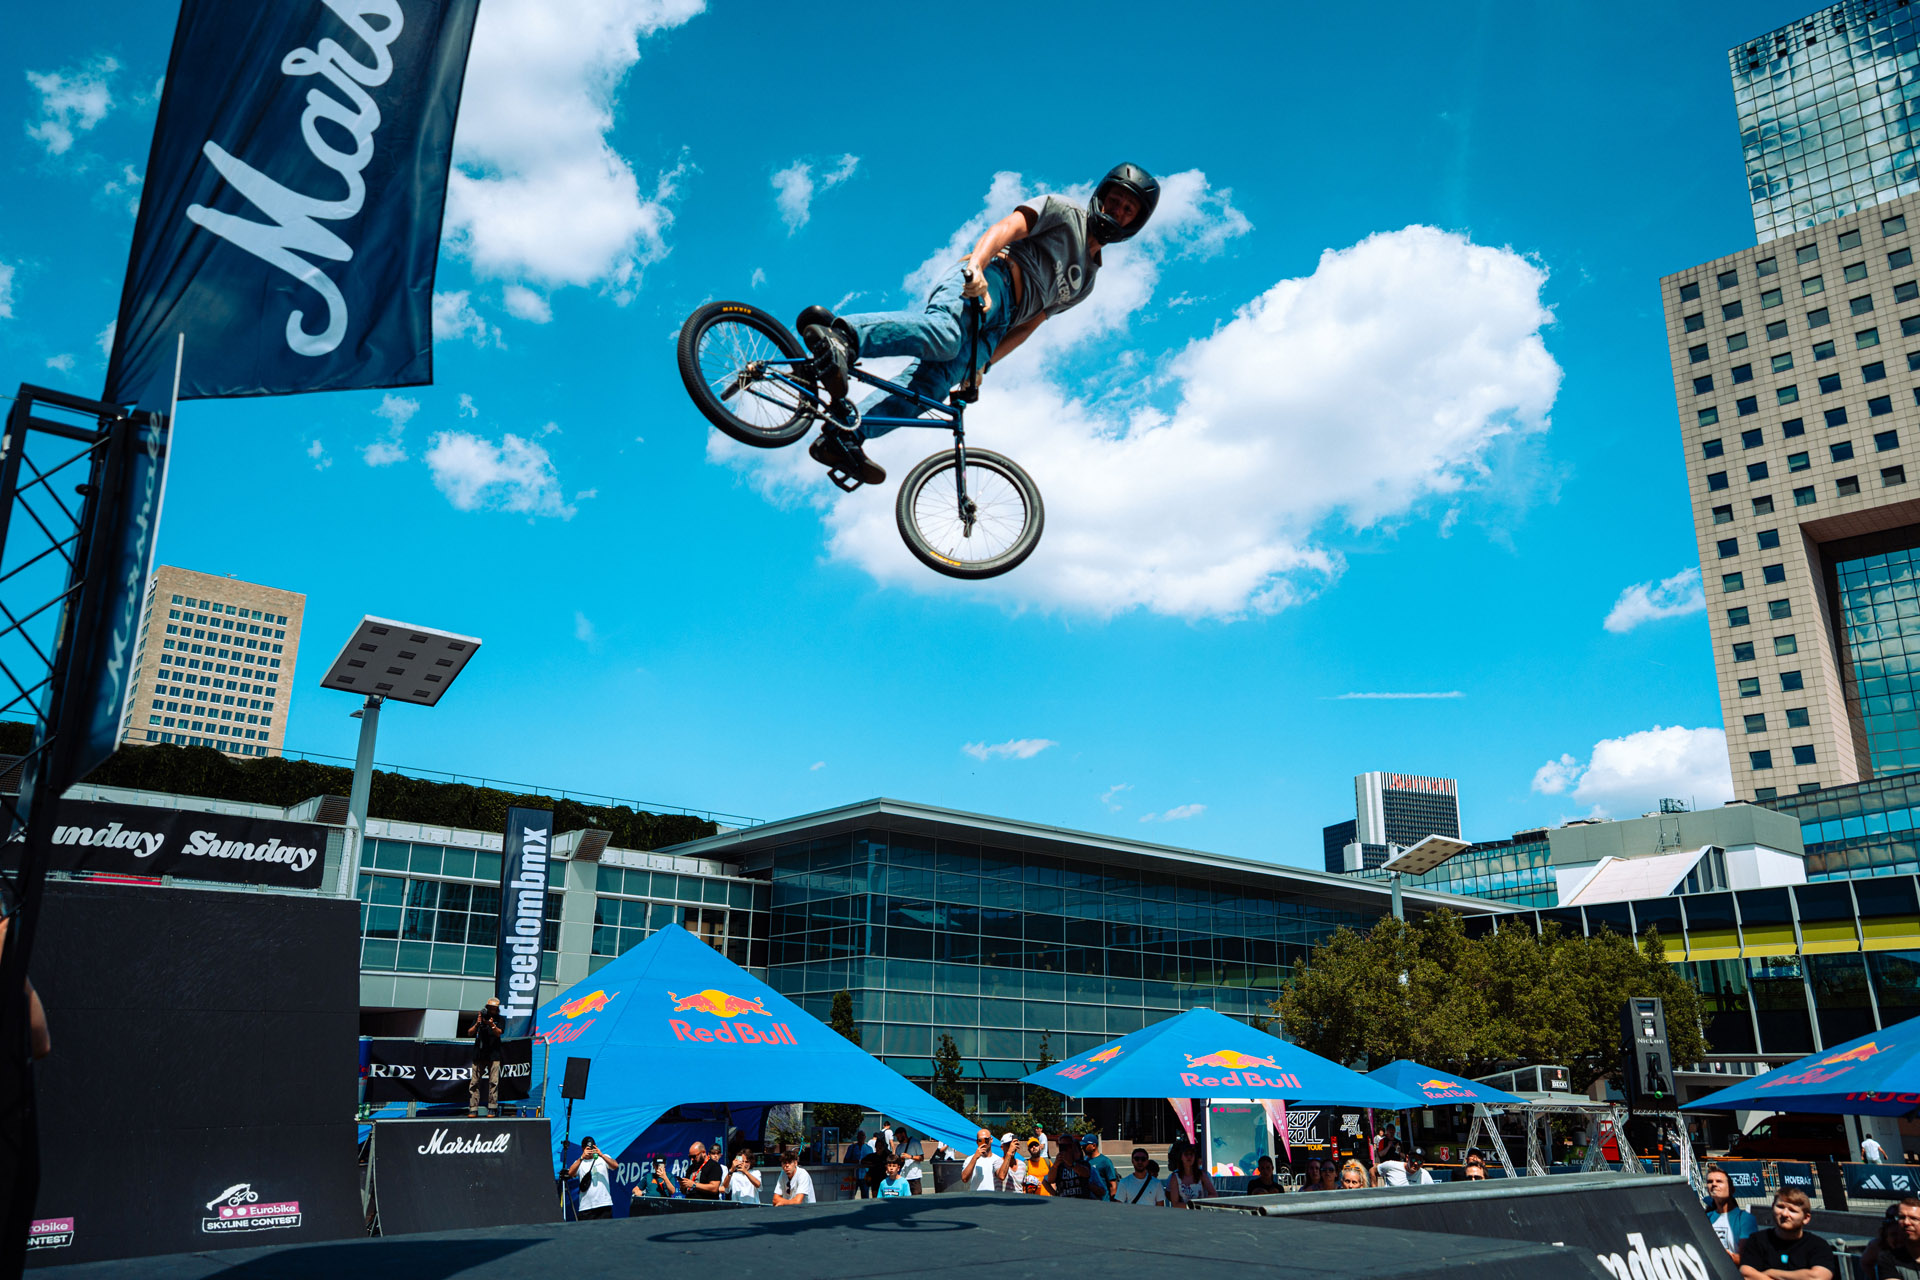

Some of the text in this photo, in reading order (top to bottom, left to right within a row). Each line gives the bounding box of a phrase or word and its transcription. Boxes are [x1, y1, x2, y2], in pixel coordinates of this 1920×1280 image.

[722, 306, 752, 314] MAXXIS
[1389, 774, 1449, 792] Marriott
[6, 822, 164, 858] unday
[182, 829, 317, 872] Sunday
[499, 826, 548, 1019] freedombmx
[668, 1018, 798, 1045] Red Bull
[369, 1063, 416, 1080] RDE
[424, 1066, 490, 1081] VERE
[1179, 1071, 1302, 1089] Red Bull
[1423, 1089, 1478, 1099] Red Bull
[1286, 1110, 1321, 1129] ROP
[418, 1128, 511, 1155] Marshall
[671, 1159, 693, 1178] AR
[250, 1204, 297, 1216] Eurobike
[29, 1221, 69, 1233] robike
[207, 1216, 298, 1230] SKYLINE CONTEST
[26, 1234, 69, 1246] NTEST
